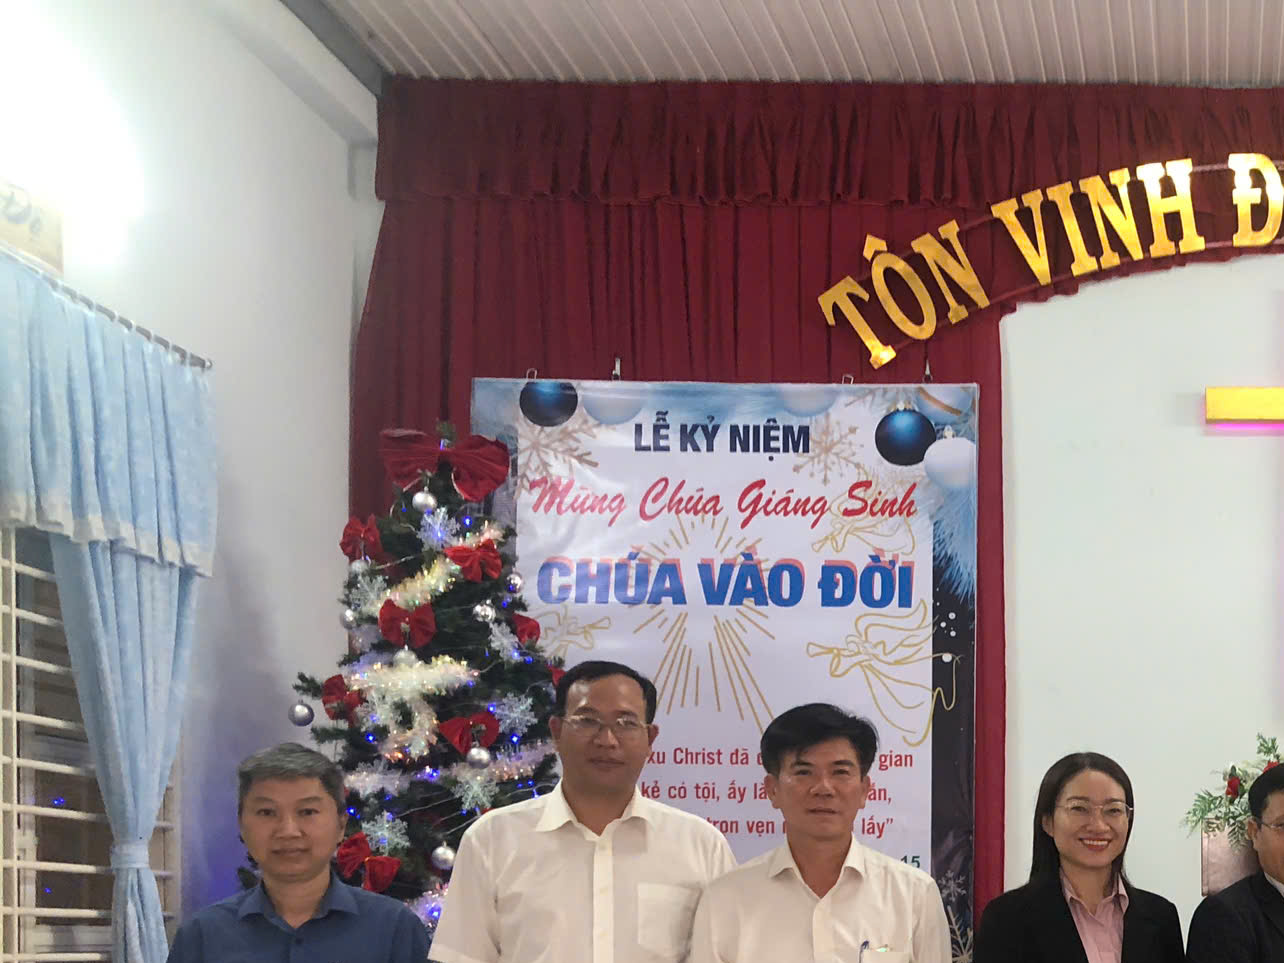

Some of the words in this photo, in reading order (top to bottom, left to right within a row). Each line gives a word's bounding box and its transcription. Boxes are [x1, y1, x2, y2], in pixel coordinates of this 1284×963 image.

[818, 220, 990, 369] TÔN
[992, 158, 1206, 286] VINH
[634, 410, 671, 452] LỄ
[679, 415, 721, 453] KỶ
[729, 417, 811, 462] NIỆM
[639, 476, 724, 522] Chúa
[737, 479, 831, 530] Giáng
[842, 480, 917, 518] Sinh
[537, 548, 688, 605] CHÚA
[697, 547, 805, 607] VÀO
[817, 547, 915, 609] ĐỜI
[673, 747, 723, 766] Christ
[729, 747, 750, 766] đã
[878, 750, 913, 771] gian
[641, 780, 661, 798] kẻ
[668, 781, 688, 800] có
[694, 782, 720, 802] tội,
[728, 780, 747, 804] ấy
[747, 820, 775, 837] vẹn
